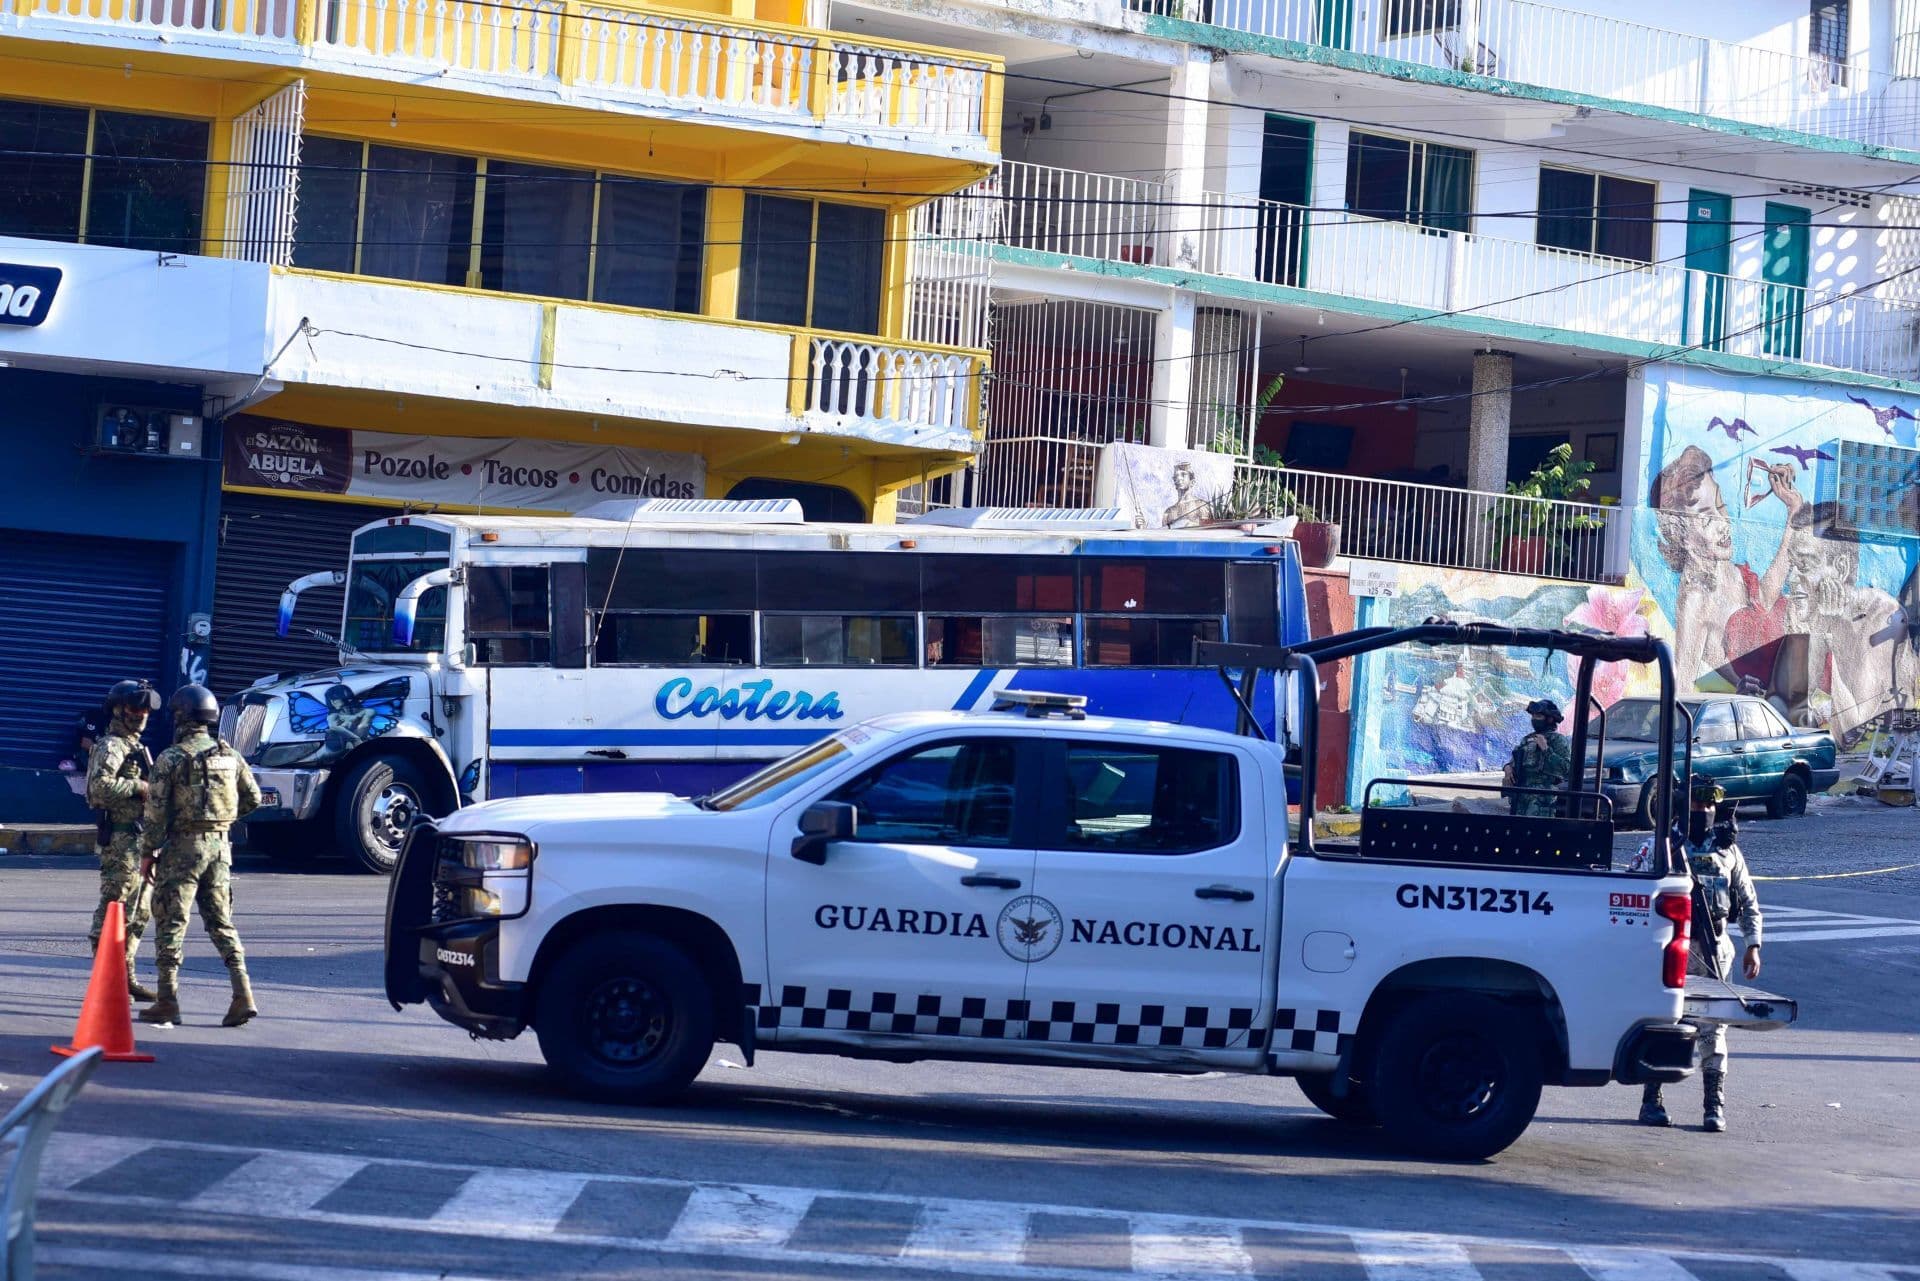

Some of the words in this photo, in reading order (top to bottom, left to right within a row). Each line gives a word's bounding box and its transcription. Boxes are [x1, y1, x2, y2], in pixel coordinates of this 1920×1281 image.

[256, 433, 318, 454] SAZÓN
[248, 453, 324, 475] ABUELA
[364, 450, 450, 480] Pozole
[483, 459, 559, 489] Tacos
[591, 467, 695, 499] Comidas
[655, 677, 844, 721] Costera
[1396, 883, 1554, 915] GN312314
[1612, 895, 1646, 907] 911
[815, 904, 990, 938] GUARDIA
[1070, 918, 1261, 953] NACIONAL
